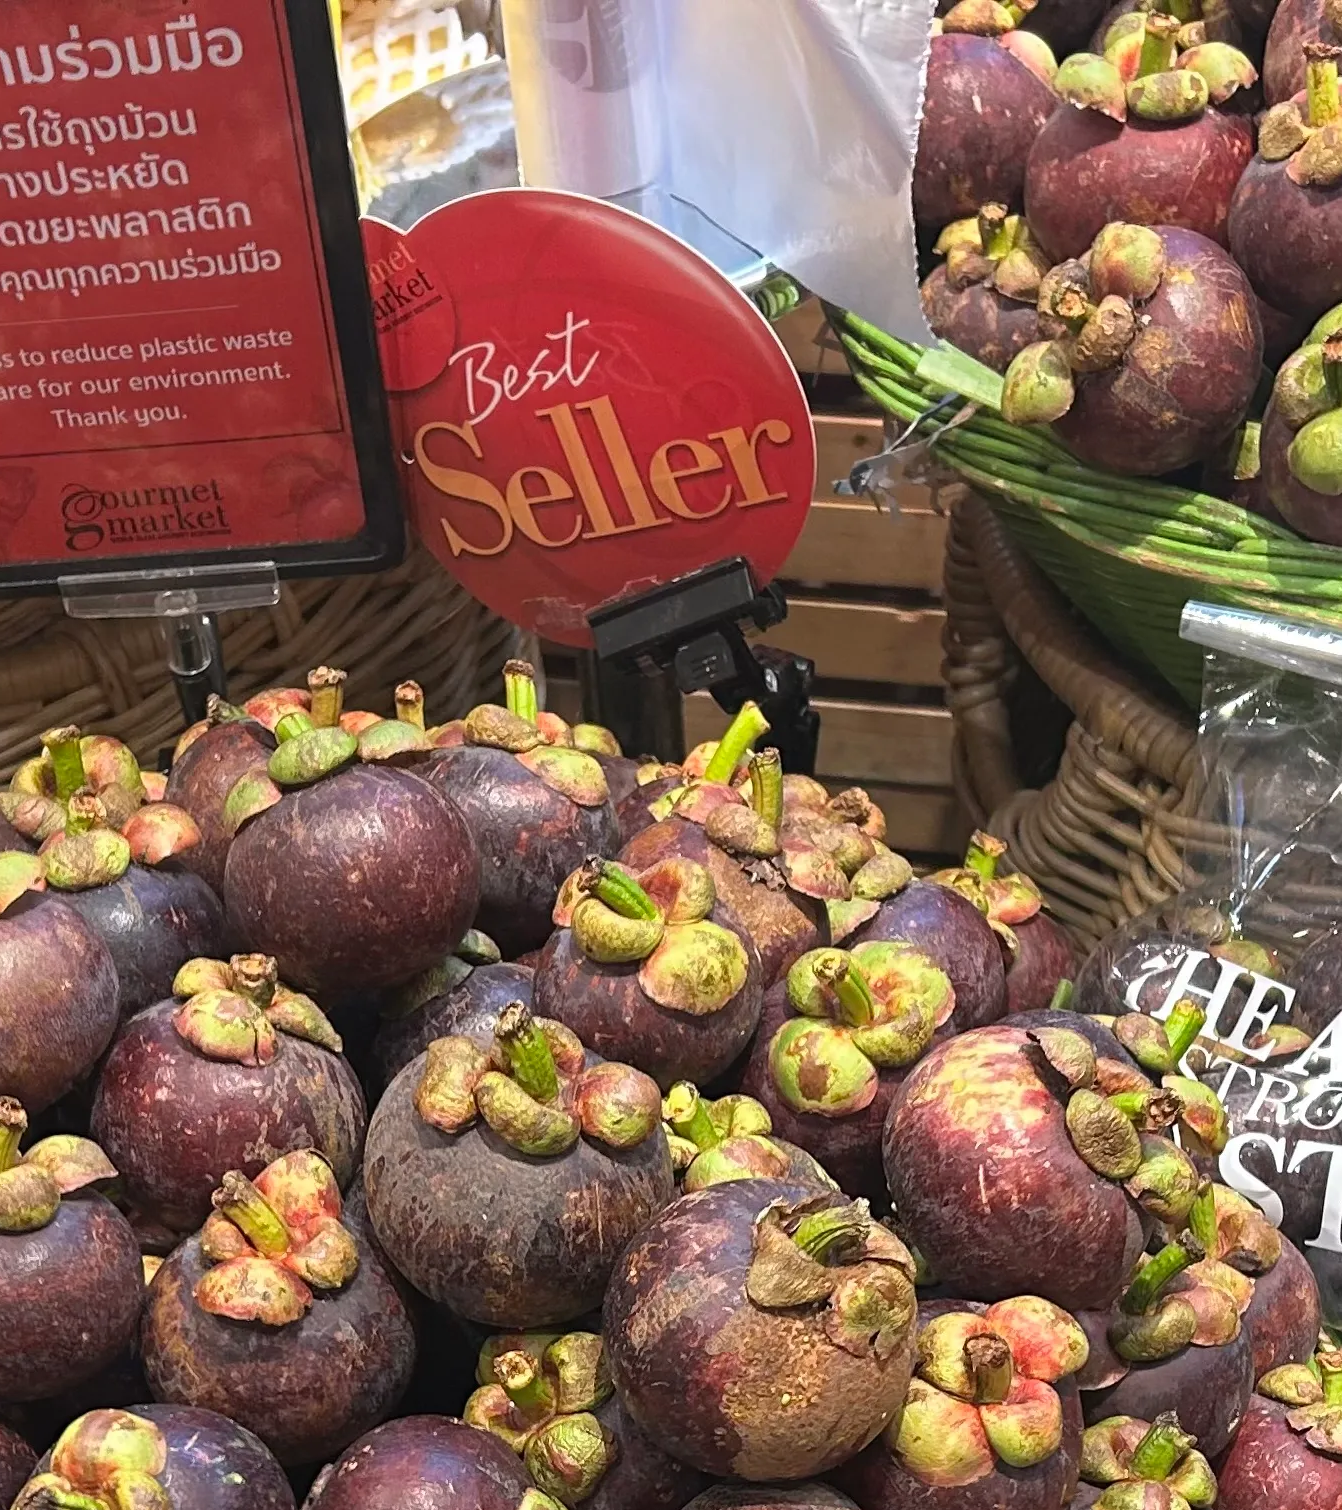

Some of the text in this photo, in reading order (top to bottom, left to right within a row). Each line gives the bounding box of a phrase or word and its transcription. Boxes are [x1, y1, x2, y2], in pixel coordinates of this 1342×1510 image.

[19, 348, 45, 367] to
[51, 341, 134, 366] reduce
[139, 334, 218, 363] plastic
[222, 328, 293, 351] waste
[37, 376, 73, 398] for
[80, 375, 122, 396] our
[129, 361, 292, 392] environment.
[448, 312, 600, 426] Best
[50, 403, 188, 430] Thank you.
[413, 394, 792, 557] Seller
[108, 502, 230, 535] market
